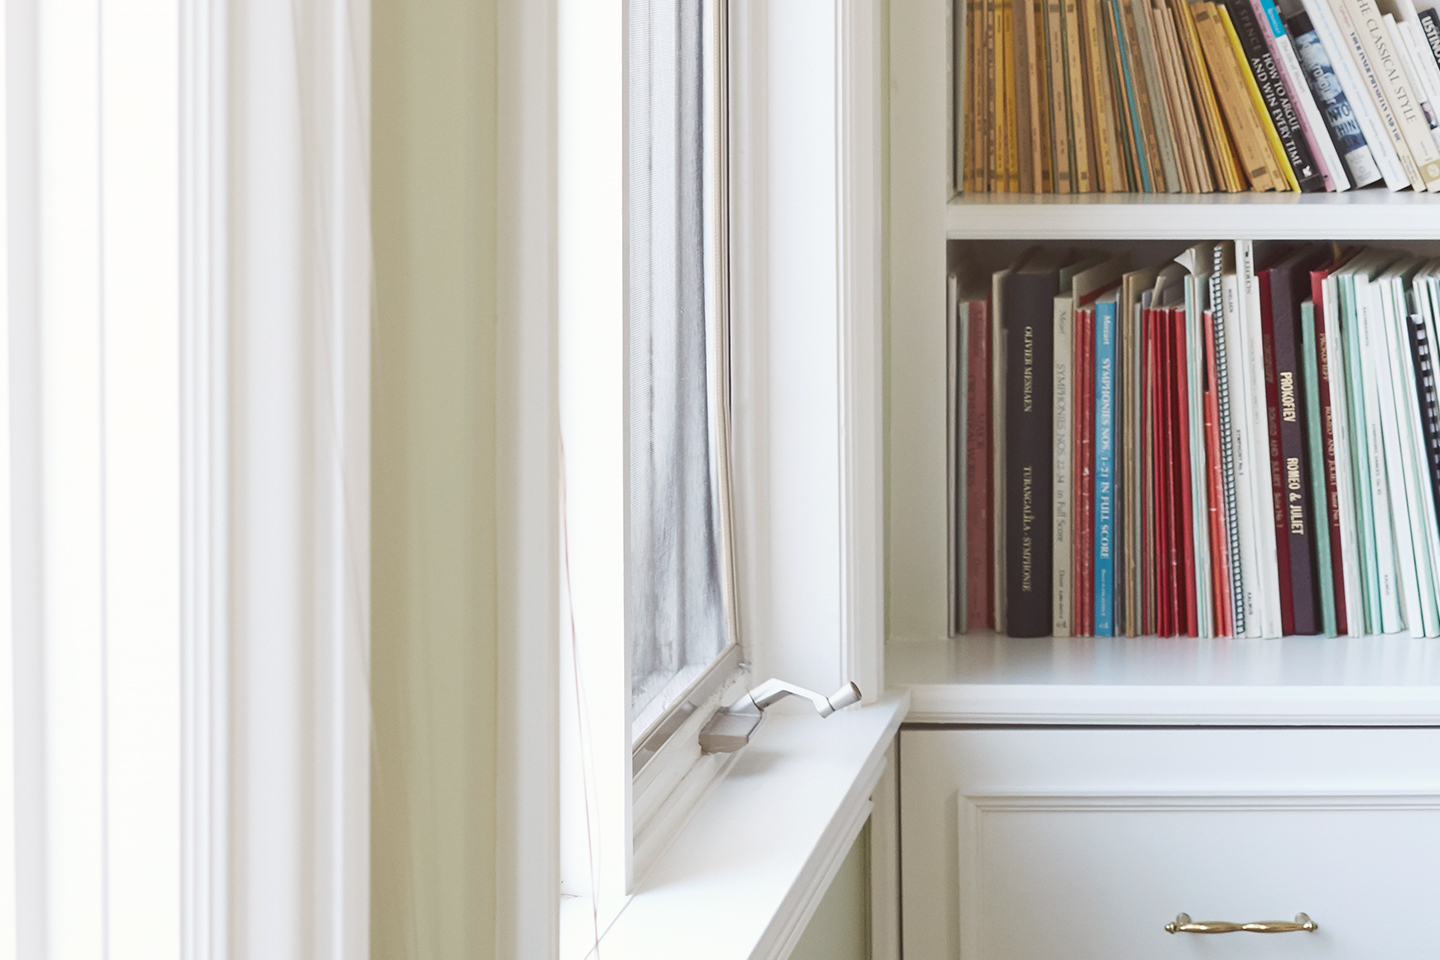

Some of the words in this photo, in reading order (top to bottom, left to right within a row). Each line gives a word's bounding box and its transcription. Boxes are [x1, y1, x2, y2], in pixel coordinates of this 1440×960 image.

[1240, 10, 1261, 52] SPENCE
[1358, 52, 1371, 74] INNER
[1367, 74, 1388, 112] PHYSICIAN
[1385, 113, 1396, 127] AND
[1365, 18, 1400, 86] CLASSICAL
[1394, 86, 1418, 125] STYLE
[1261, 52, 1278, 79] HOW
[1274, 80, 1286, 96] TO
[1280, 98, 1301, 132] ARGUE
[1250, 57, 1270, 81] AND
[1262, 82, 1279, 107] WIN
[1271, 108, 1291, 139] EVERY
[1285, 140, 1303, 166] TIME
[1023, 326, 1033, 365] OLIVIER
[1103, 315, 1111, 345] Mozart
[1023, 366, 1033, 413] MESSIAEN
[1056, 363, 1066, 430] SYMPHONIES
[1101, 358, 1111, 425] SYMPHONIES
[1279, 371, 1296, 423] PROKOFIEV
[1056, 433, 1066, 456] NOS.
[1101, 428, 1110, 452] NOS.
[1100, 456, 1109, 478] 1-21
[1286, 457, 1301, 490] ROMEO
[1100, 481, 1110, 493] IN
[1289, 492, 1302, 503] &
[1056, 501, 1066, 518] Full
[1100, 496, 1109, 523] FULL
[1289, 504, 1304, 535] JULIET
[1056, 519, 1066, 543] Score
[1100, 524, 1109, 560] SCORE
[1022, 536, 1032, 592] SYMPHONIE
